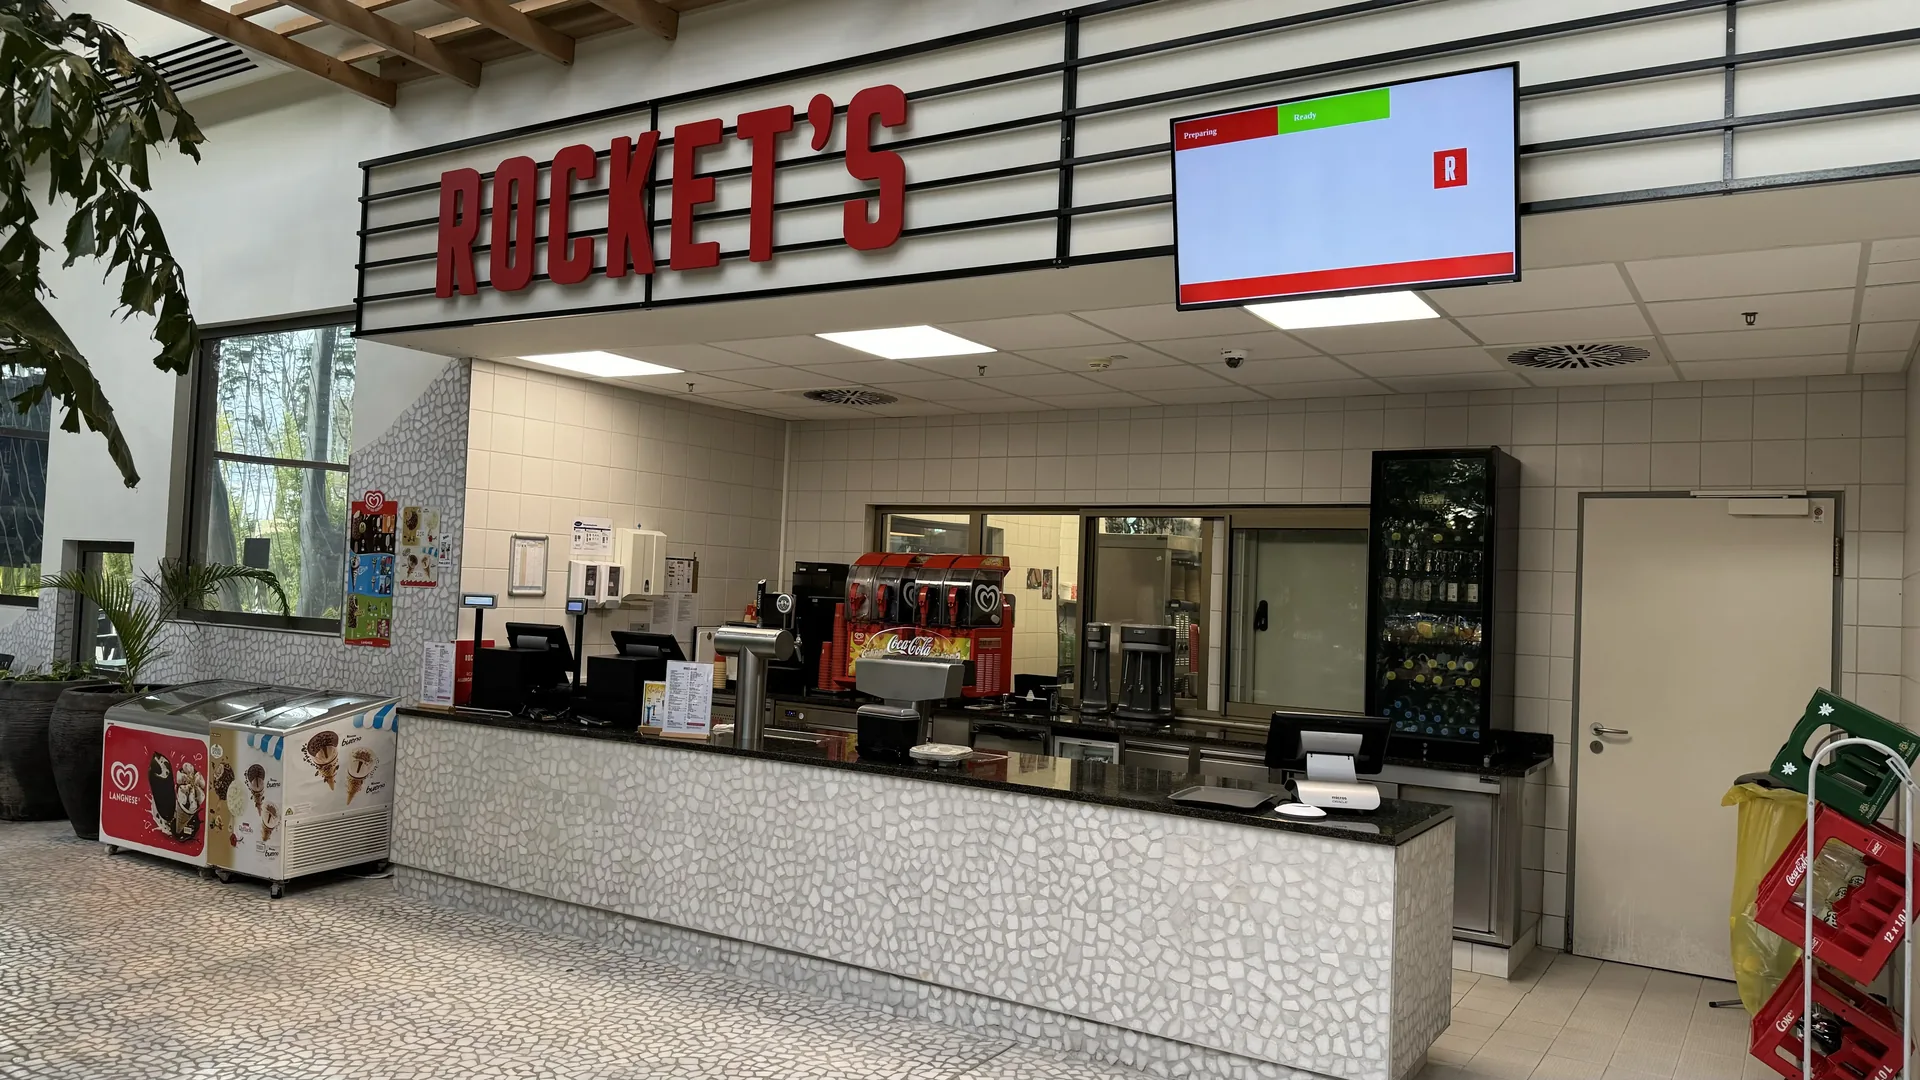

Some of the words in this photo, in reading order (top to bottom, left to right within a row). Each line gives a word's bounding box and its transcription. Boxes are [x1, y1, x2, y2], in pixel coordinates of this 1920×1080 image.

[1294, 112, 1317, 121] Ready
[1183, 128, 1217, 139] Preparing
[1444, 156, 1456, 182] R
[435, 84, 907, 299] ROCKET'S
[887, 634, 933, 656] Coca-Cola
[109, 791, 139, 805] LANGNESE
[1884, 931, 1895, 943] 12
[1891, 926, 1899, 935] x
[1775, 1011, 1795, 1033] Coke
